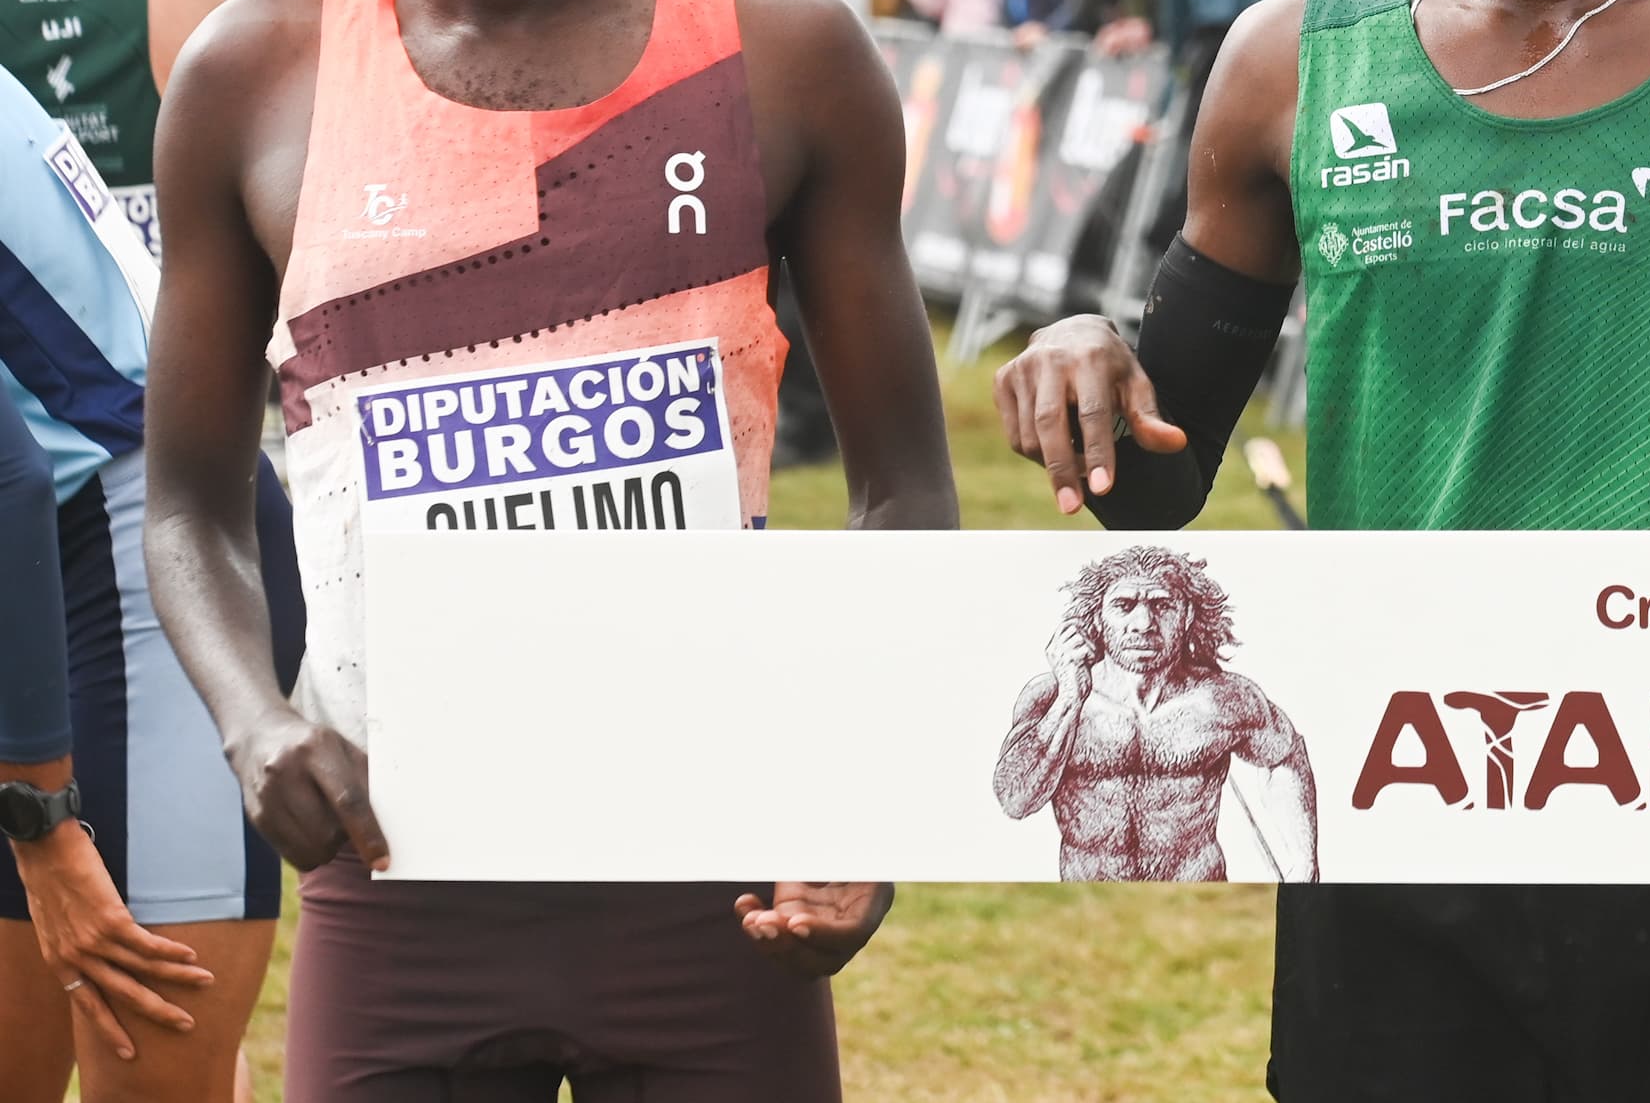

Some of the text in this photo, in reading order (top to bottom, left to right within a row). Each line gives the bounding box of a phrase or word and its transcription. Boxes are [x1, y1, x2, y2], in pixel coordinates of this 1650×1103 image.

[1320, 154, 1410, 188] rasán
[1439, 188, 1628, 236] Facsa
[391, 226, 427, 239] Camp
[1351, 219, 1412, 238] Ajuntament de
[1352, 230, 1413, 255] Castelló
[1464, 236, 1626, 254] ciclo integral del agua
[1364, 252, 1398, 265] Esports
[370, 354, 701, 438] DIPUTACIÓN
[376, 398, 706, 492] BURGOS
